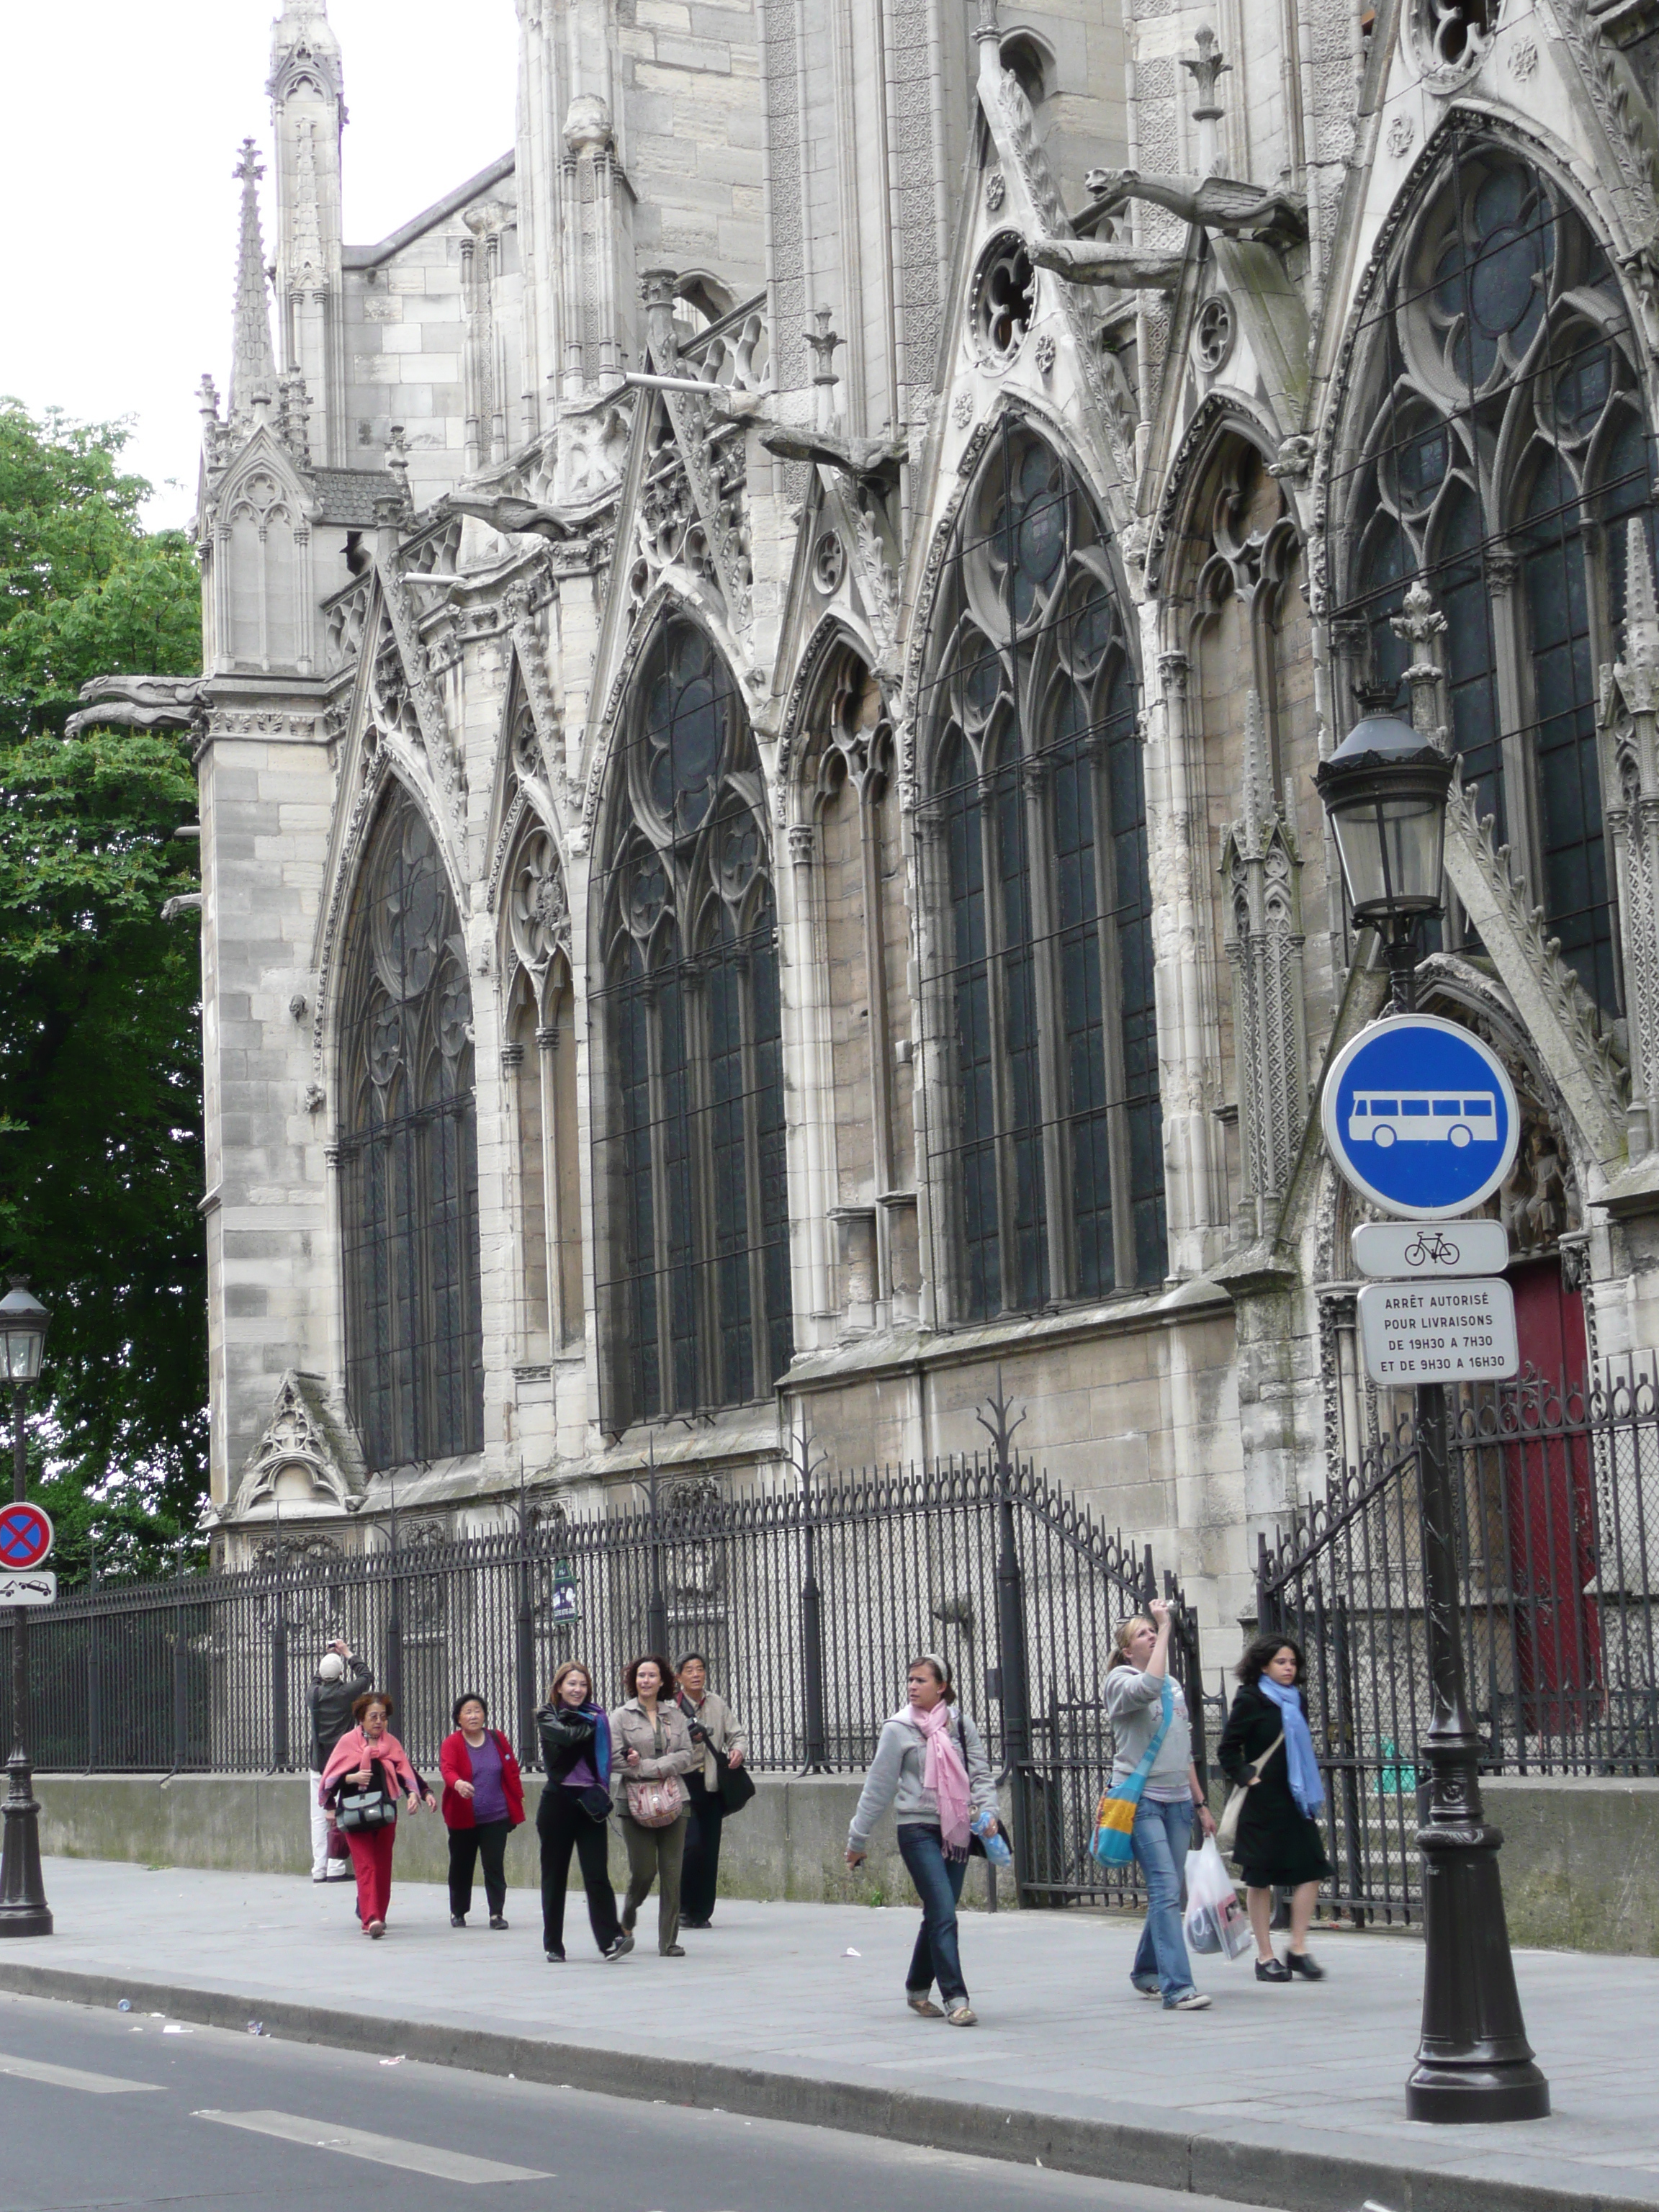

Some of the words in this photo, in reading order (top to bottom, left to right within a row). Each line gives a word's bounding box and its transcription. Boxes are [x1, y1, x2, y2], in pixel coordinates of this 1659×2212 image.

[1385, 1294, 1424, 1309] ARRÊT
[1430, 1292, 1489, 1307] AUTORISÉ
[1384, 1318, 1416, 1330] POUR
[1421, 1314, 1493, 1328] LIVRAISONS
[1388, 1339, 1404, 1351] DE
[1408, 1338, 1444, 1349] 19H30
[1450, 1337, 1458, 1348] A
[1462, 1335, 1493, 1347] 7H30
[1380, 1361, 1395, 1372] ET
[1400, 1360, 1416, 1371] DE
[1420, 1358, 1451, 1370] 9H30
[1457, 1357, 1464, 1368] A
[1469, 1355, 1505, 1367] 16H30
